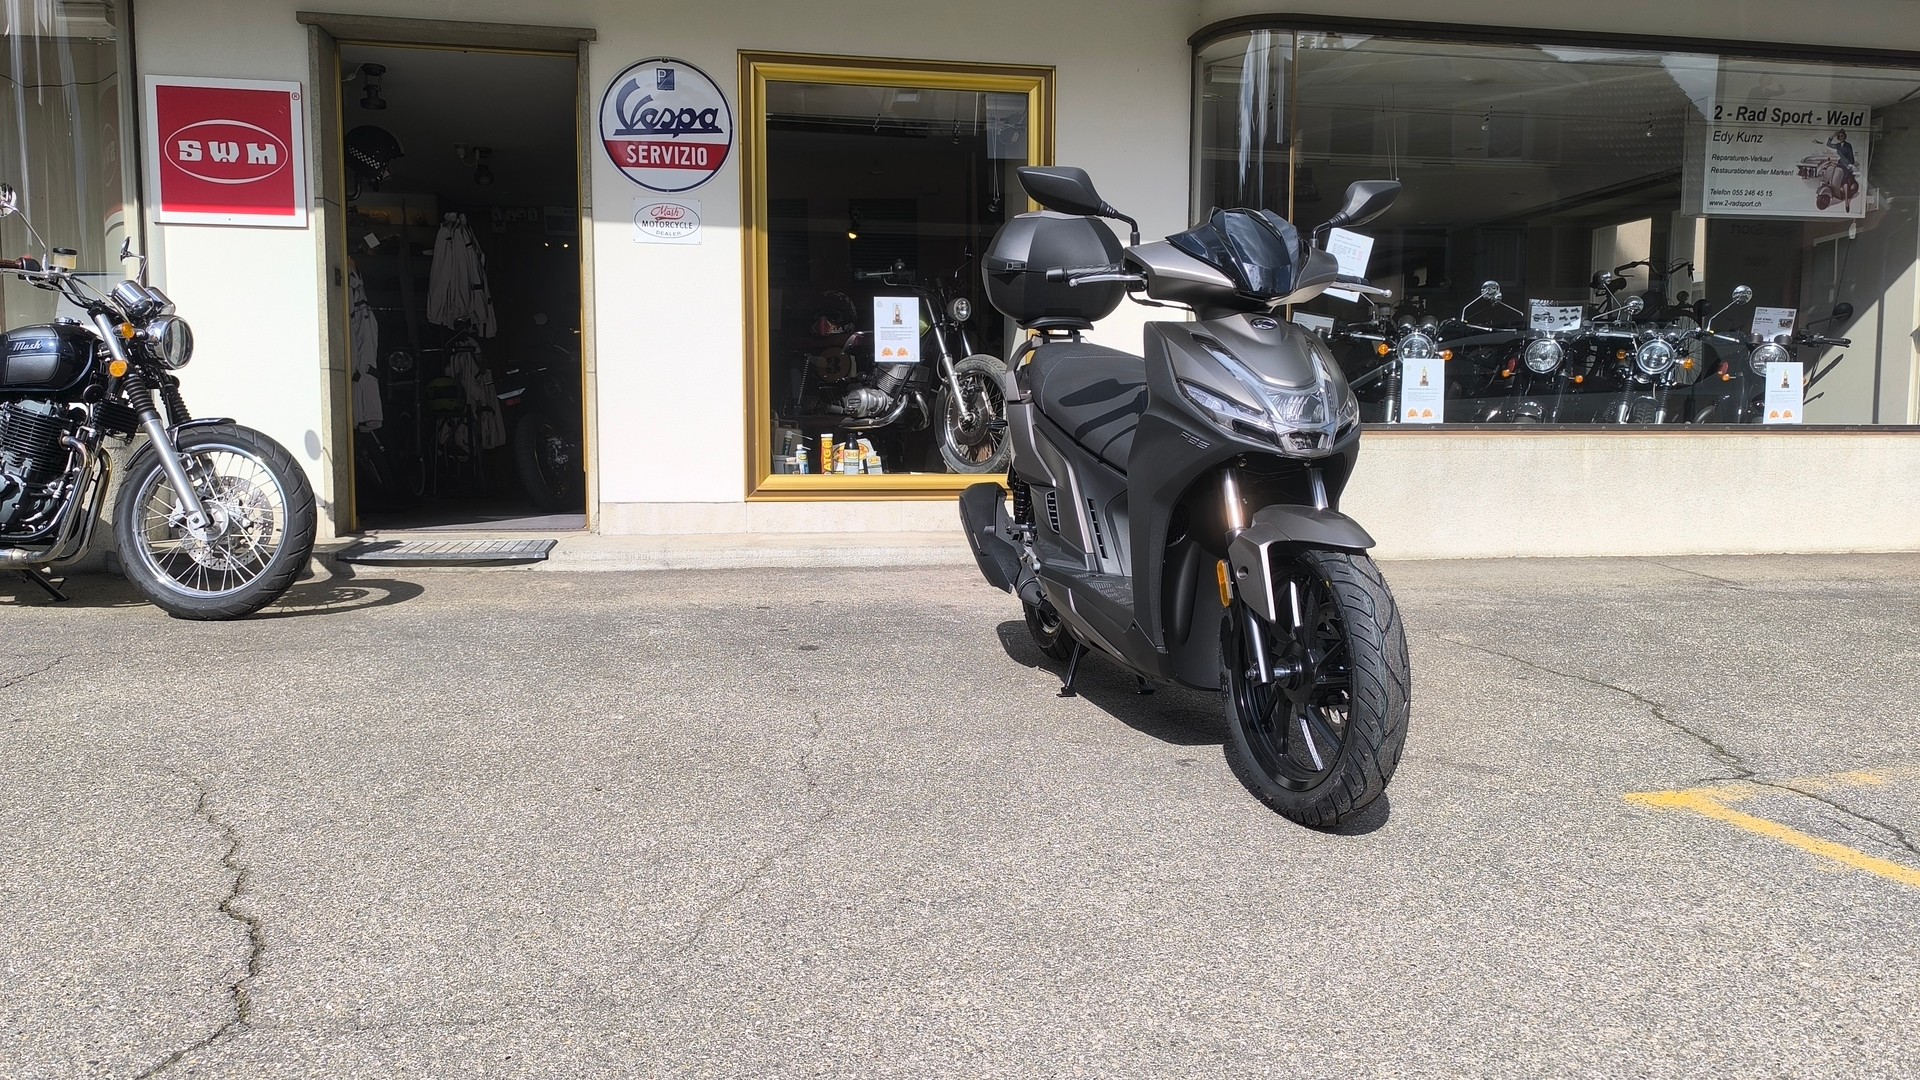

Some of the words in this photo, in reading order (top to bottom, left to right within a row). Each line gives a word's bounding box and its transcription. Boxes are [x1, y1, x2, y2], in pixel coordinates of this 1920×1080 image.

[613, 78, 724, 138] Vespa
[1713, 105, 1723, 120] 2
[1735, 105, 1767, 122] Rad
[1770, 107, 1813, 126] Sport
[1826, 110, 1865, 127] Wald
[1712, 130, 1734, 145] Edy
[1735, 131, 1764, 144] Kunz
[178, 140, 278, 165] SWM
[626, 144, 709, 167] SERVIZIO
[1711, 153, 1774, 164] Reparaturen-Verkauf
[1710, 166, 1756, 176] Restaurationen
[1756, 167, 1770, 176] aller
[1770, 168, 1795, 177] Marken!
[1709, 188, 1731, 197] Telefon
[1744, 189, 1756, 197] 246
[1709, 200, 1762, 208] www.2-radsport.ch
[651, 205, 685, 221] Mash
[641, 219, 693, 230] MOTORCYCLE
[13, 340, 42, 352] Mash
